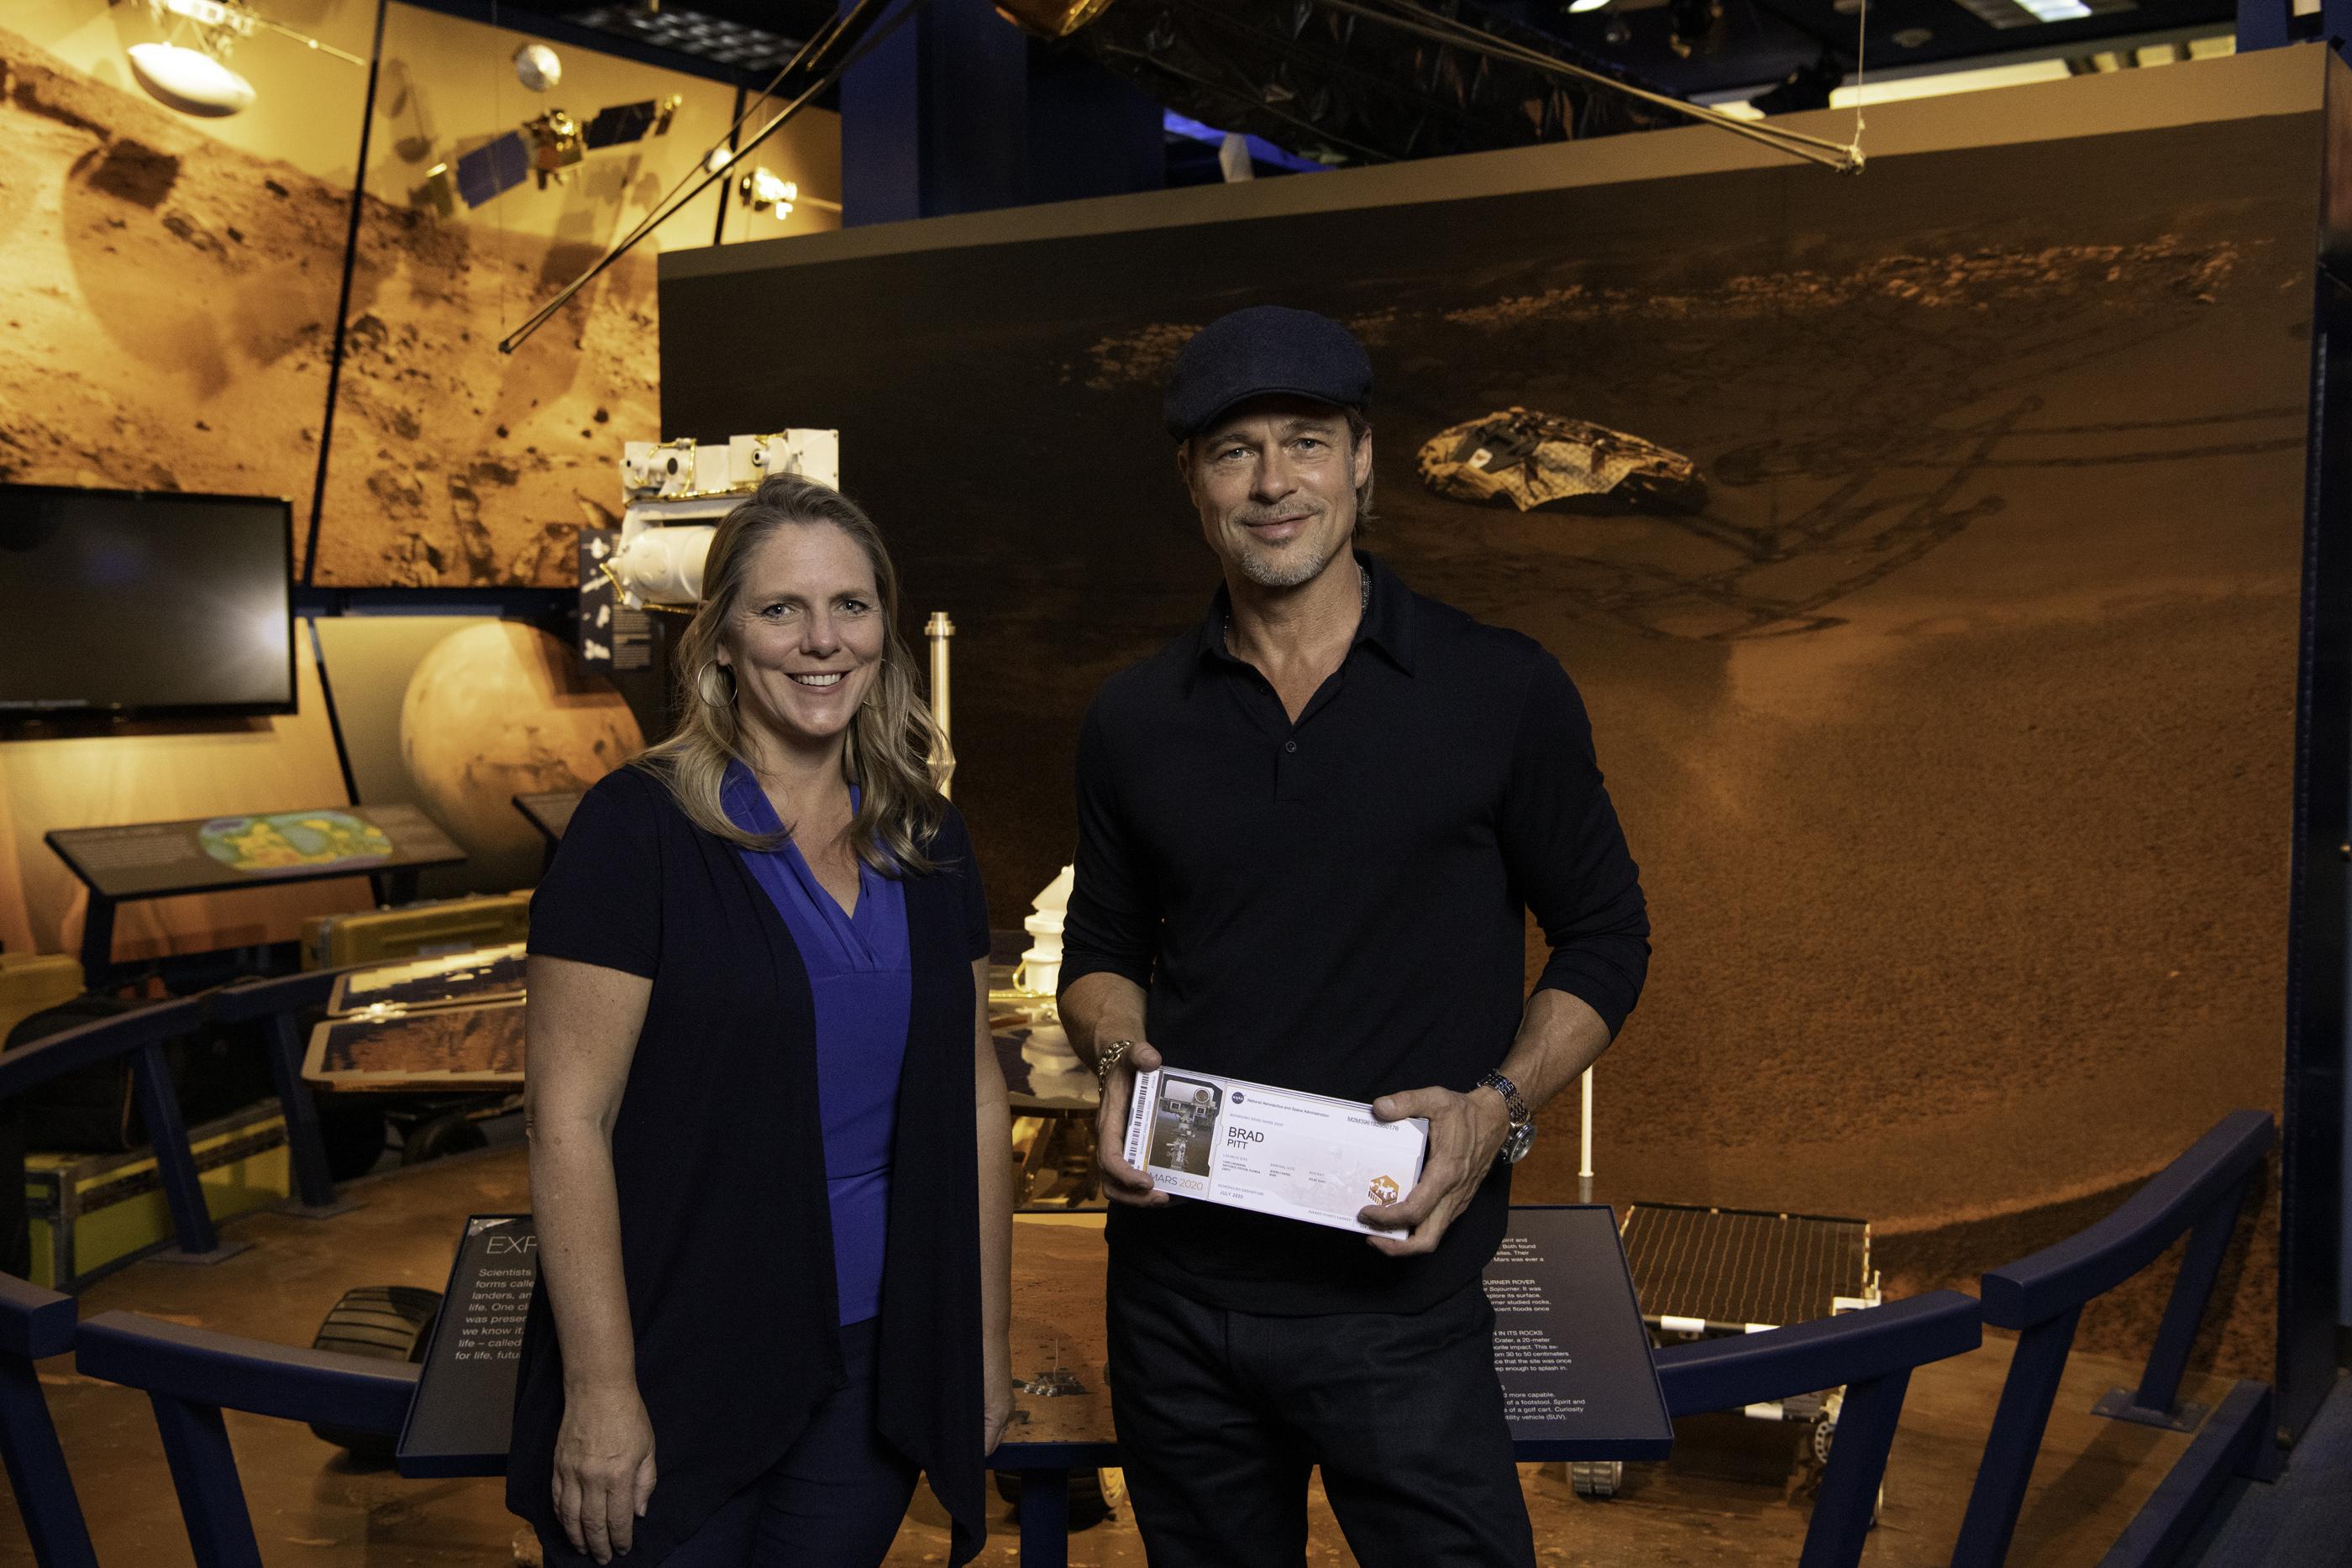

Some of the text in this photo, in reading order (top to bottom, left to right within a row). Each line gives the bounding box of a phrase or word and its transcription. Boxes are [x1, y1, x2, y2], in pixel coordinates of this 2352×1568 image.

[1228, 1126, 1264, 1143] BRAD
[1227, 1139, 1248, 1150] PITT
[1149, 1172, 1204, 1190] MARS 2020
[479, 1268, 532, 1277] Scientists
[472, 1292, 515, 1300] landers,
[488, 1339, 522, 1347] called
[455, 1351, 470, 1360] for
[474, 1351, 492, 1360] life,
